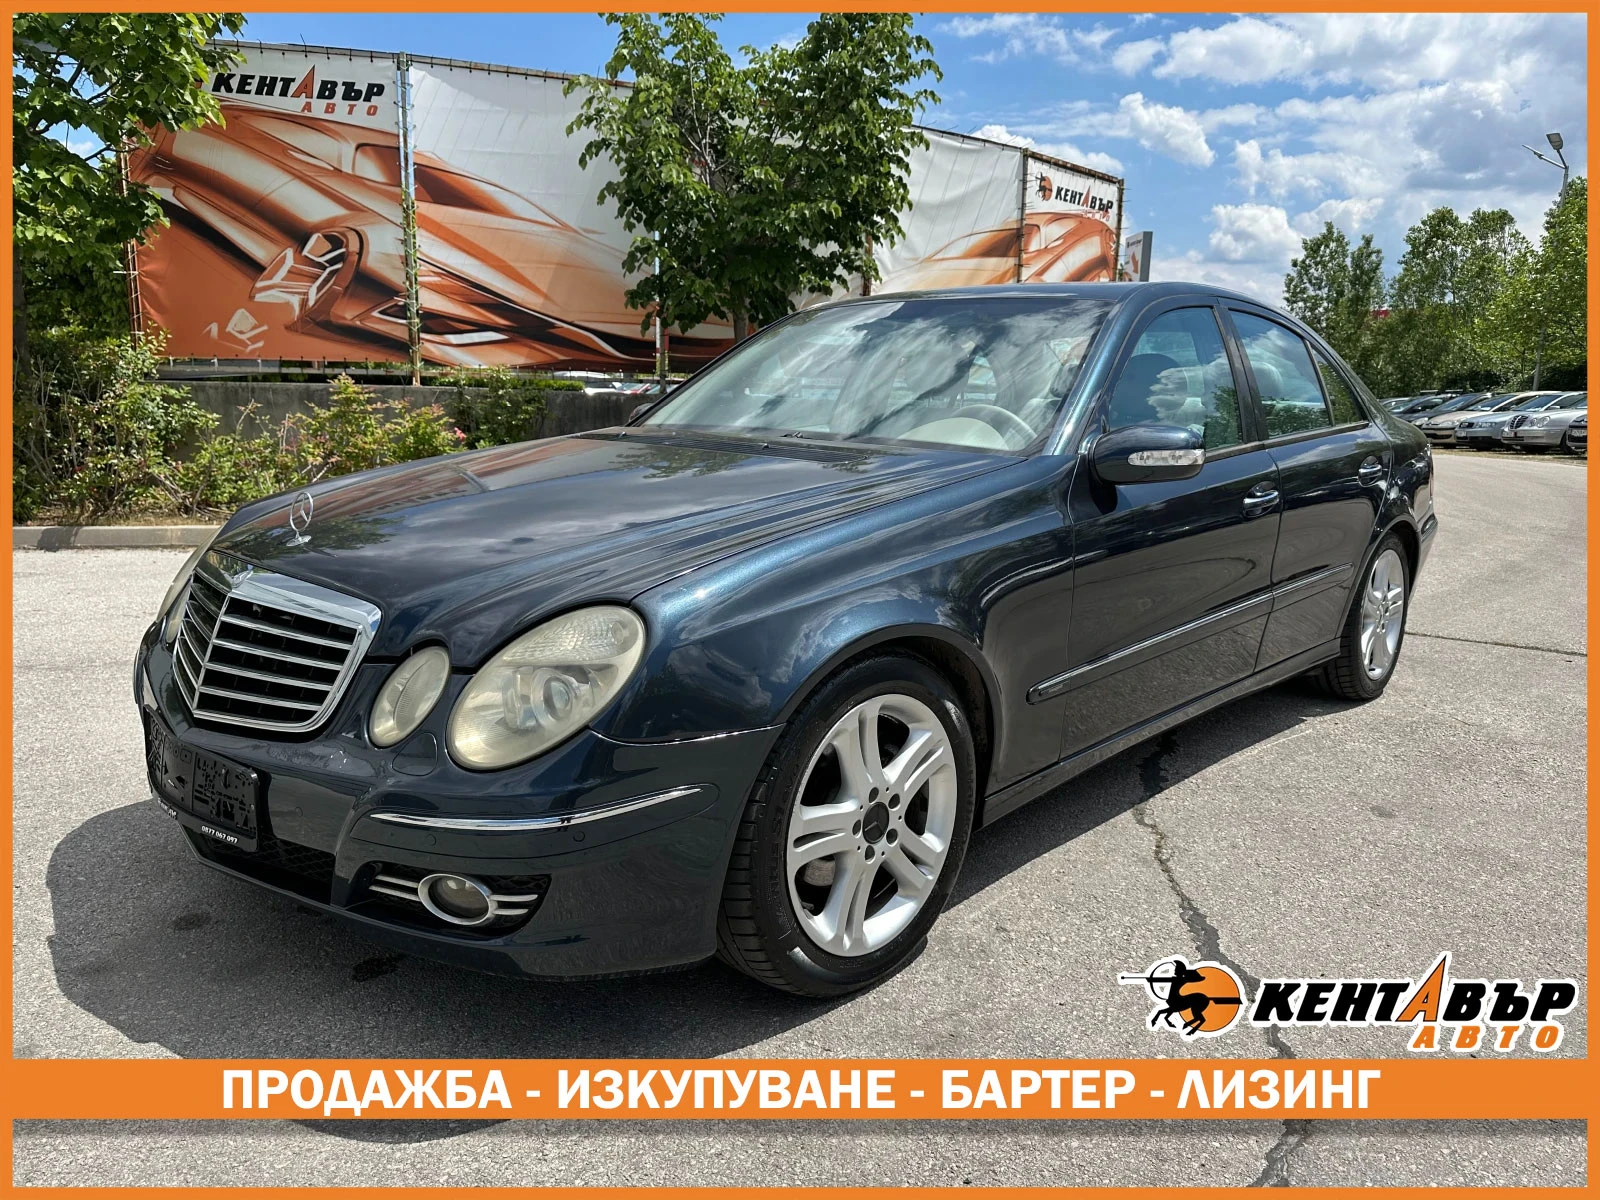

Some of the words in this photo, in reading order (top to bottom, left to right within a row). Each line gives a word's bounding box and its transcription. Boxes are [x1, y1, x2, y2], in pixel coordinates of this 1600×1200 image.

[211, 64, 386, 102] КЕНТАВЪР
[300, 101, 379, 117] АВТО
[1054, 185, 1114, 212] КЕНТАВЪР
[201, 825, 215, 836] 0877
[215, 831, 226, 840] 067
[226, 835, 238, 844] 097
